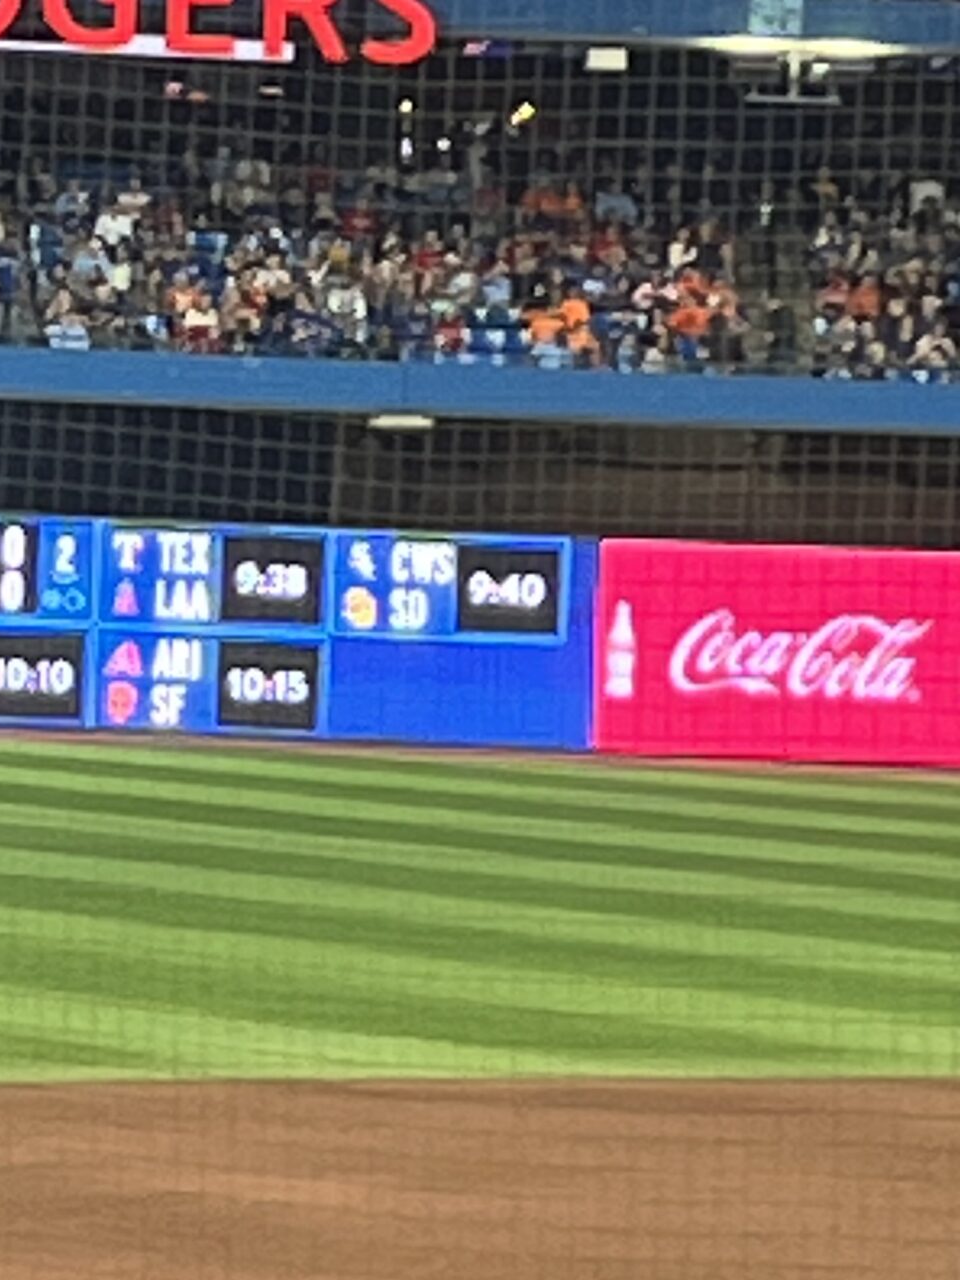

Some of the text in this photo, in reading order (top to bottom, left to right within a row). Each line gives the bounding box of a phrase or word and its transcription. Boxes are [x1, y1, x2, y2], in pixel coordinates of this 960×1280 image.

[1, 525, 26, 568] 0
[55, 534, 77, 573] 2
[155, 530, 212, 575] TEX
[0, 570, 26, 612] 0
[391, 541, 457, 586] CWS
[468, 570, 547, 608] 9:40
[154, 578, 211, 621] LAA
[388, 587, 429, 630] SD
[152, 637, 203, 682] ARI
[227, 666, 310, 704] 10:15
[149, 683, 188, 727] SF
